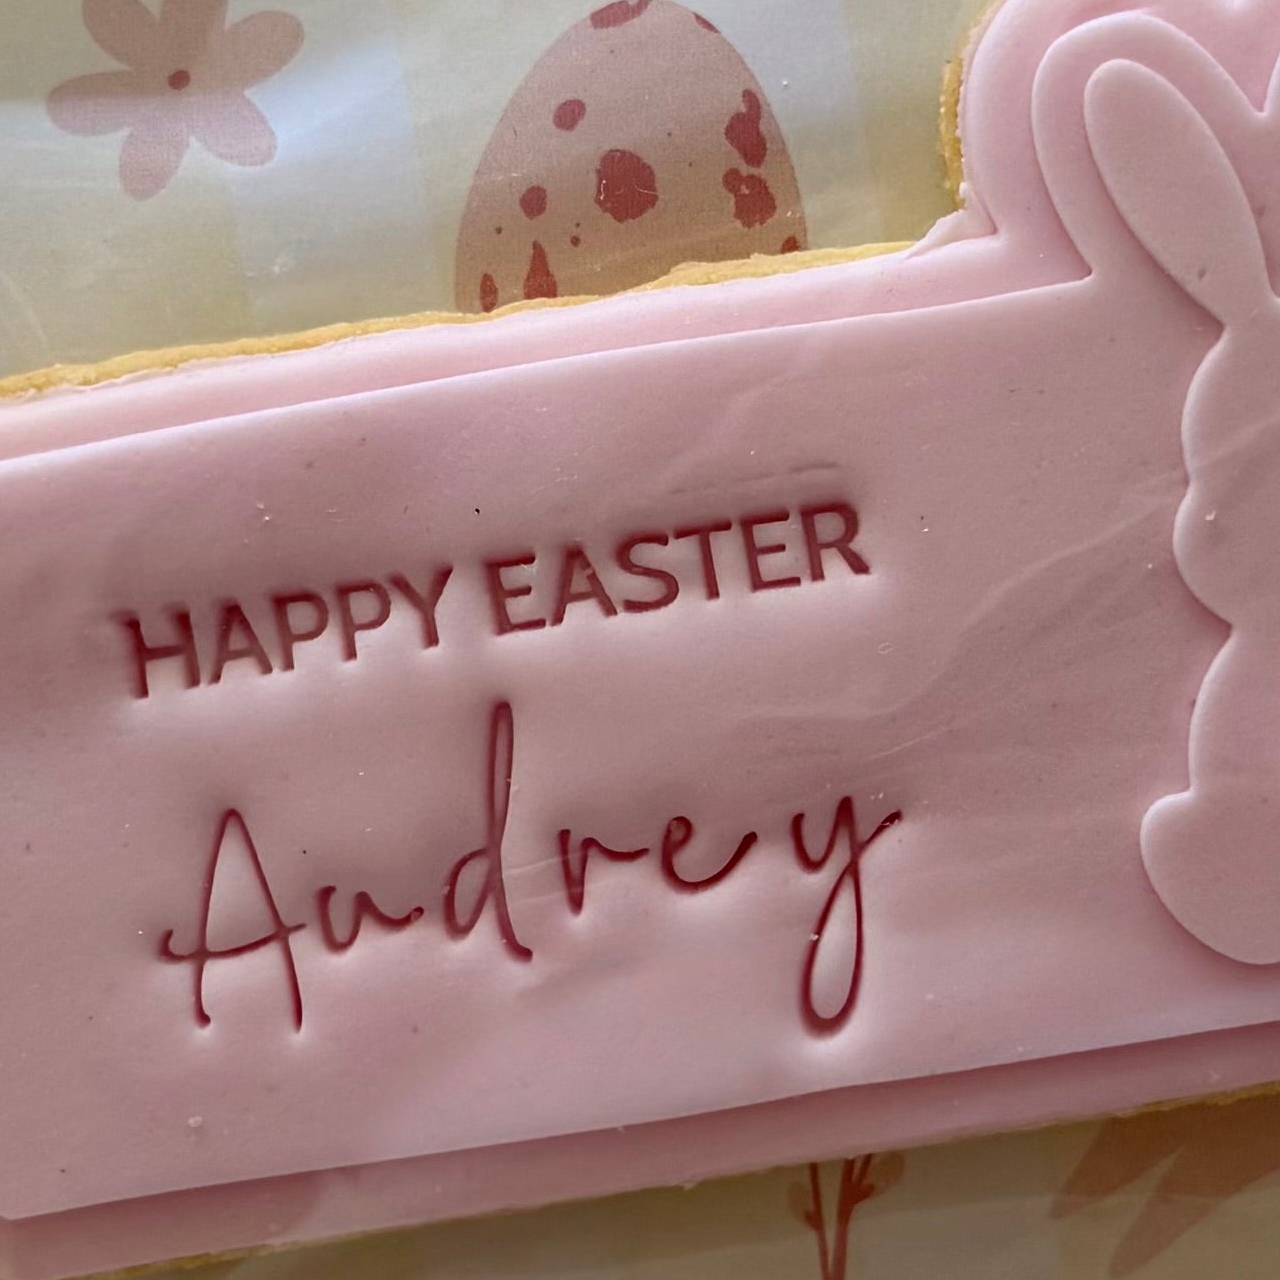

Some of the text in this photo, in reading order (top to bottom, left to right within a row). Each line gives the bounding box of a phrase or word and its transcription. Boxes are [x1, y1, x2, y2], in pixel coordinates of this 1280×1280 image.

[121, 500, 871, 699] HAPPY EASTER
[157, 701, 903, 1037] Audrey
